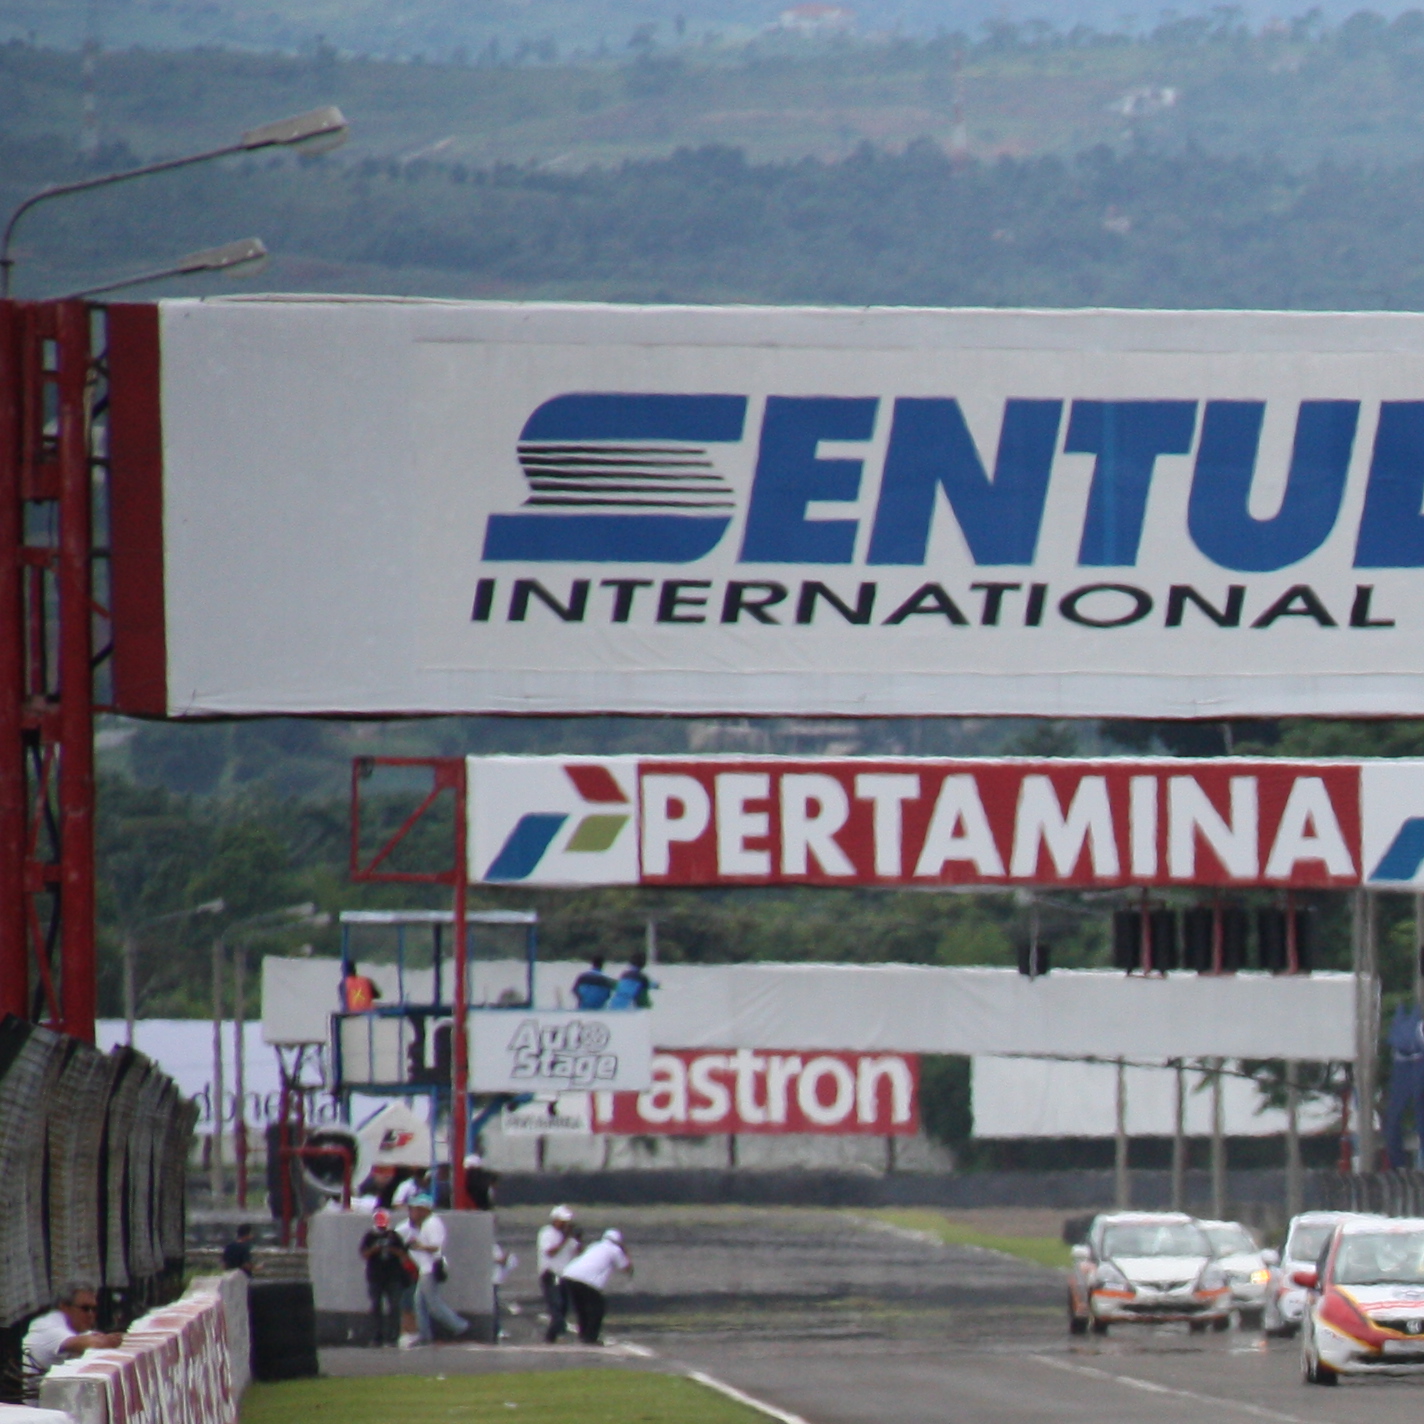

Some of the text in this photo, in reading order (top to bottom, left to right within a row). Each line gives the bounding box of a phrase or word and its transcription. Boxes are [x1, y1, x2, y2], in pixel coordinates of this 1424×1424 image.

[470, 577, 1396, 629] INTERNATIONAL
[642, 773, 1355, 880] PERTAMINA
[508, 1019, 611, 1052] Auto
[510, 1045, 617, 1091] Stage
